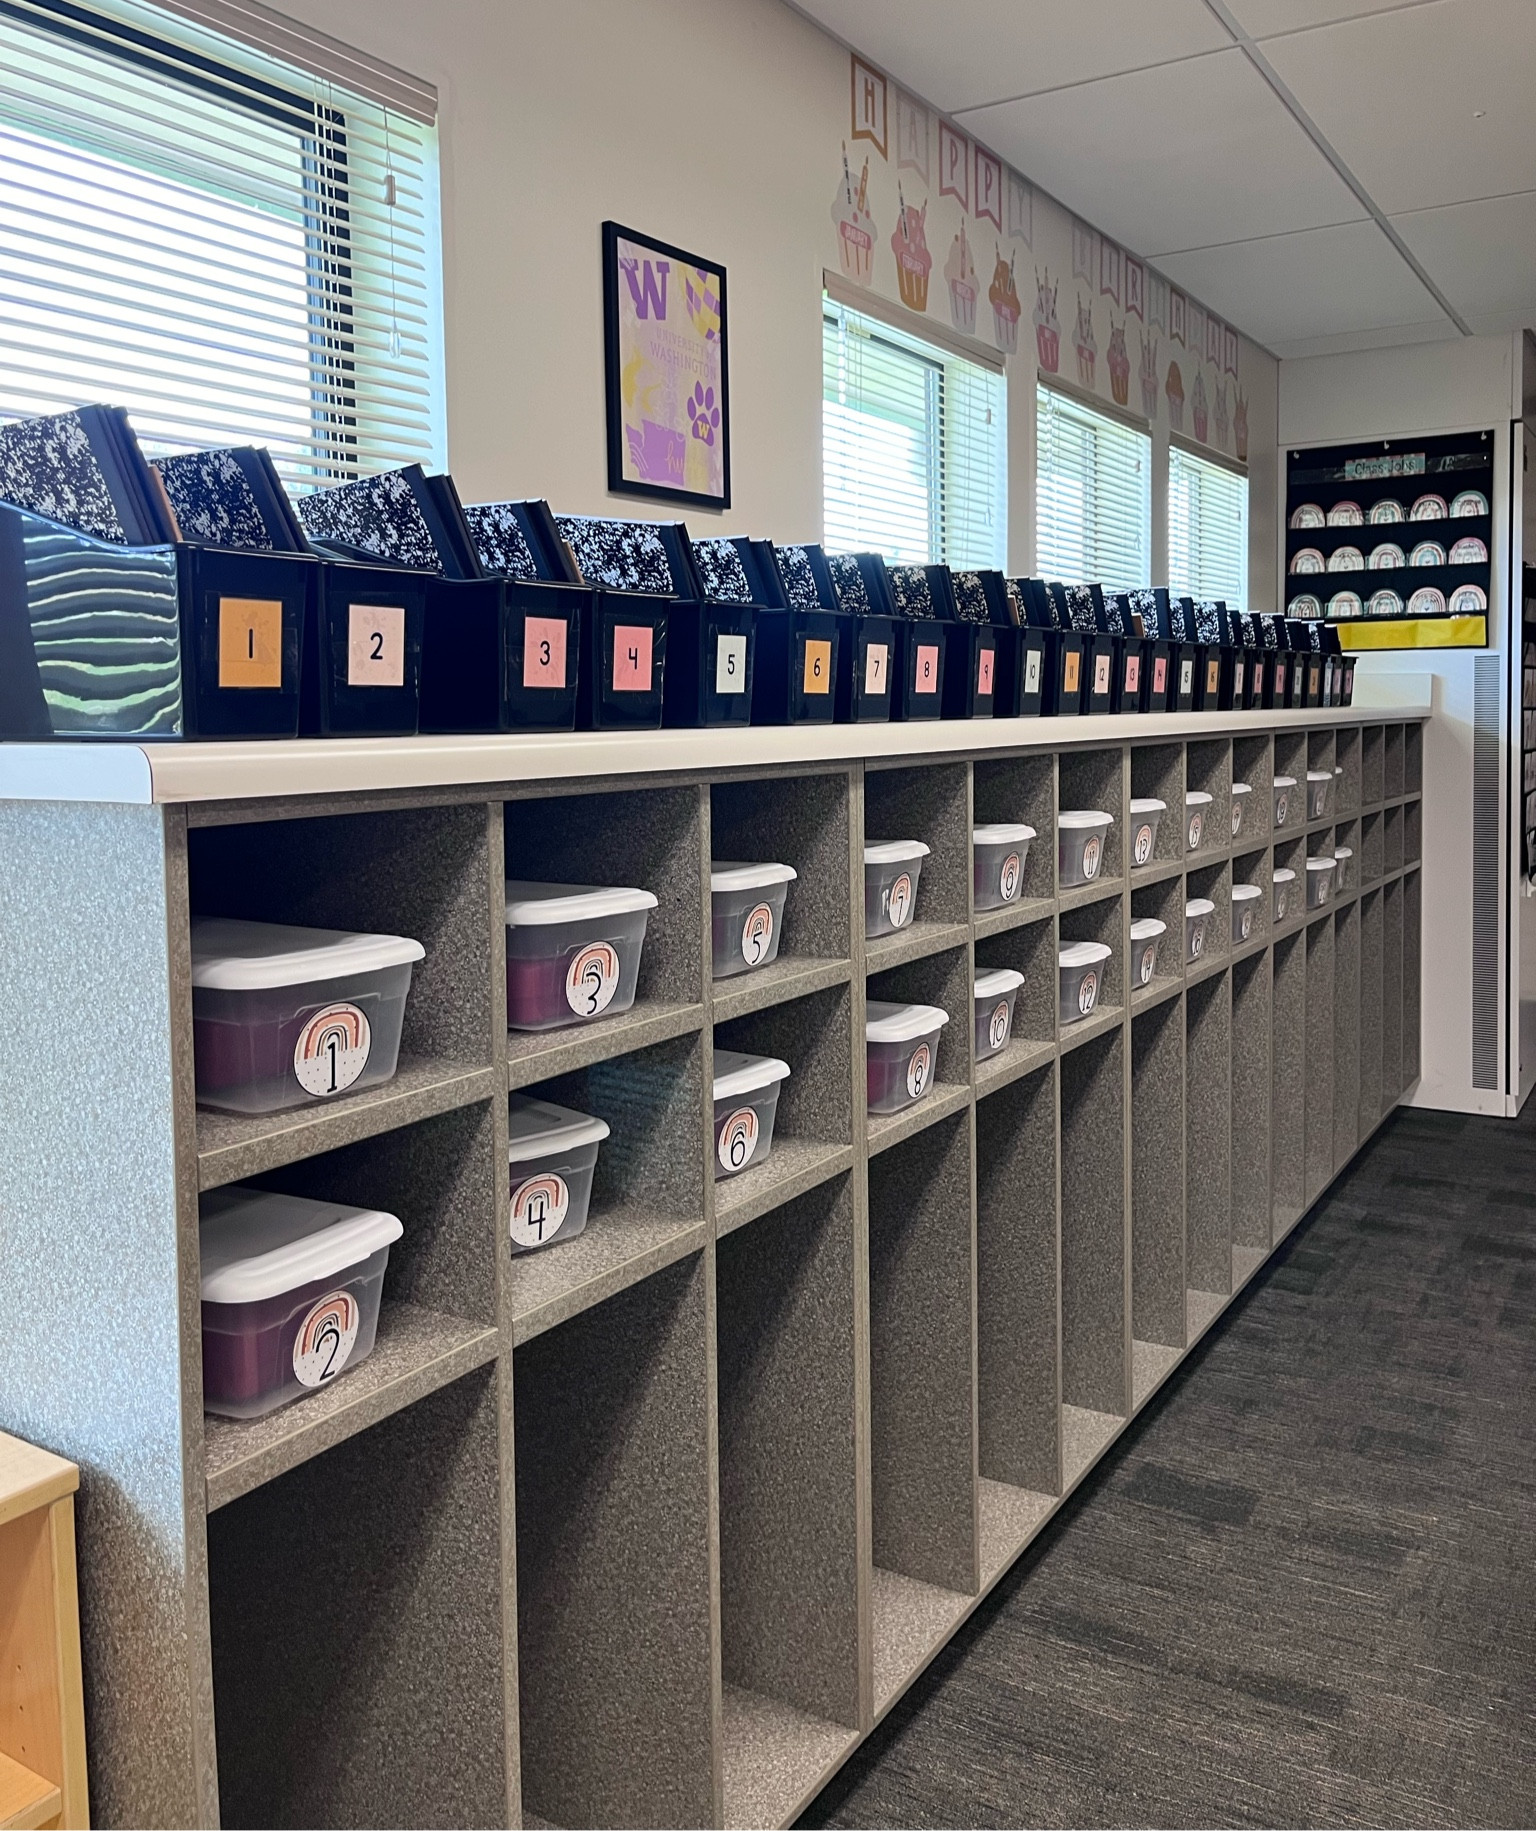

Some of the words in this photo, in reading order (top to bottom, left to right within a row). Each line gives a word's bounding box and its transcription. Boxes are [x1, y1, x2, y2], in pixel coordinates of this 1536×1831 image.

[864, 77, 1024, 224] HAPPY
[618, 257, 670, 321] W
[656, 327, 704, 360] UNIVERSITY
[649, 341, 717, 380] WASHINGTON
[697, 420, 710, 440] W
[1355, 462, 1384, 475] Class
[1388, 459, 1416, 473] Jobs
[248, 628, 254, 659] 1
[369, 632, 384, 660] 2
[539, 640, 551, 666] 3
[628, 646, 638, 670] 4
[727, 653, 736, 675] 5
[813, 657, 821, 677] 6
[873, 660, 880, 678] 7
[923, 661, 930, 678] 8
[984, 664, 989, 680] 9
[1029, 664, 1036, 679] 10
[1069, 665, 1074, 679] 11
[1099, 668, 1105, 682] 12
[1129, 667, 1135, 681] 13
[1184, 670, 1189, 683] 15
[1087, 850, 1095, 875] 11
[1138, 839, 1148, 862] 13
[1005, 870, 1014, 899] 9
[897, 895, 904, 924] 7
[751, 931, 763, 964] 5
[585, 971, 601, 1015] 3
[1082, 988, 1093, 1011] 12
[992, 1019, 1005, 1046] 10
[326, 1042, 338, 1093] 1
[914, 1066, 923, 1096] 8
[730, 1131, 746, 1167] 6
[527, 1201, 546, 1240] 4
[315, 1328, 340, 1382] 2
